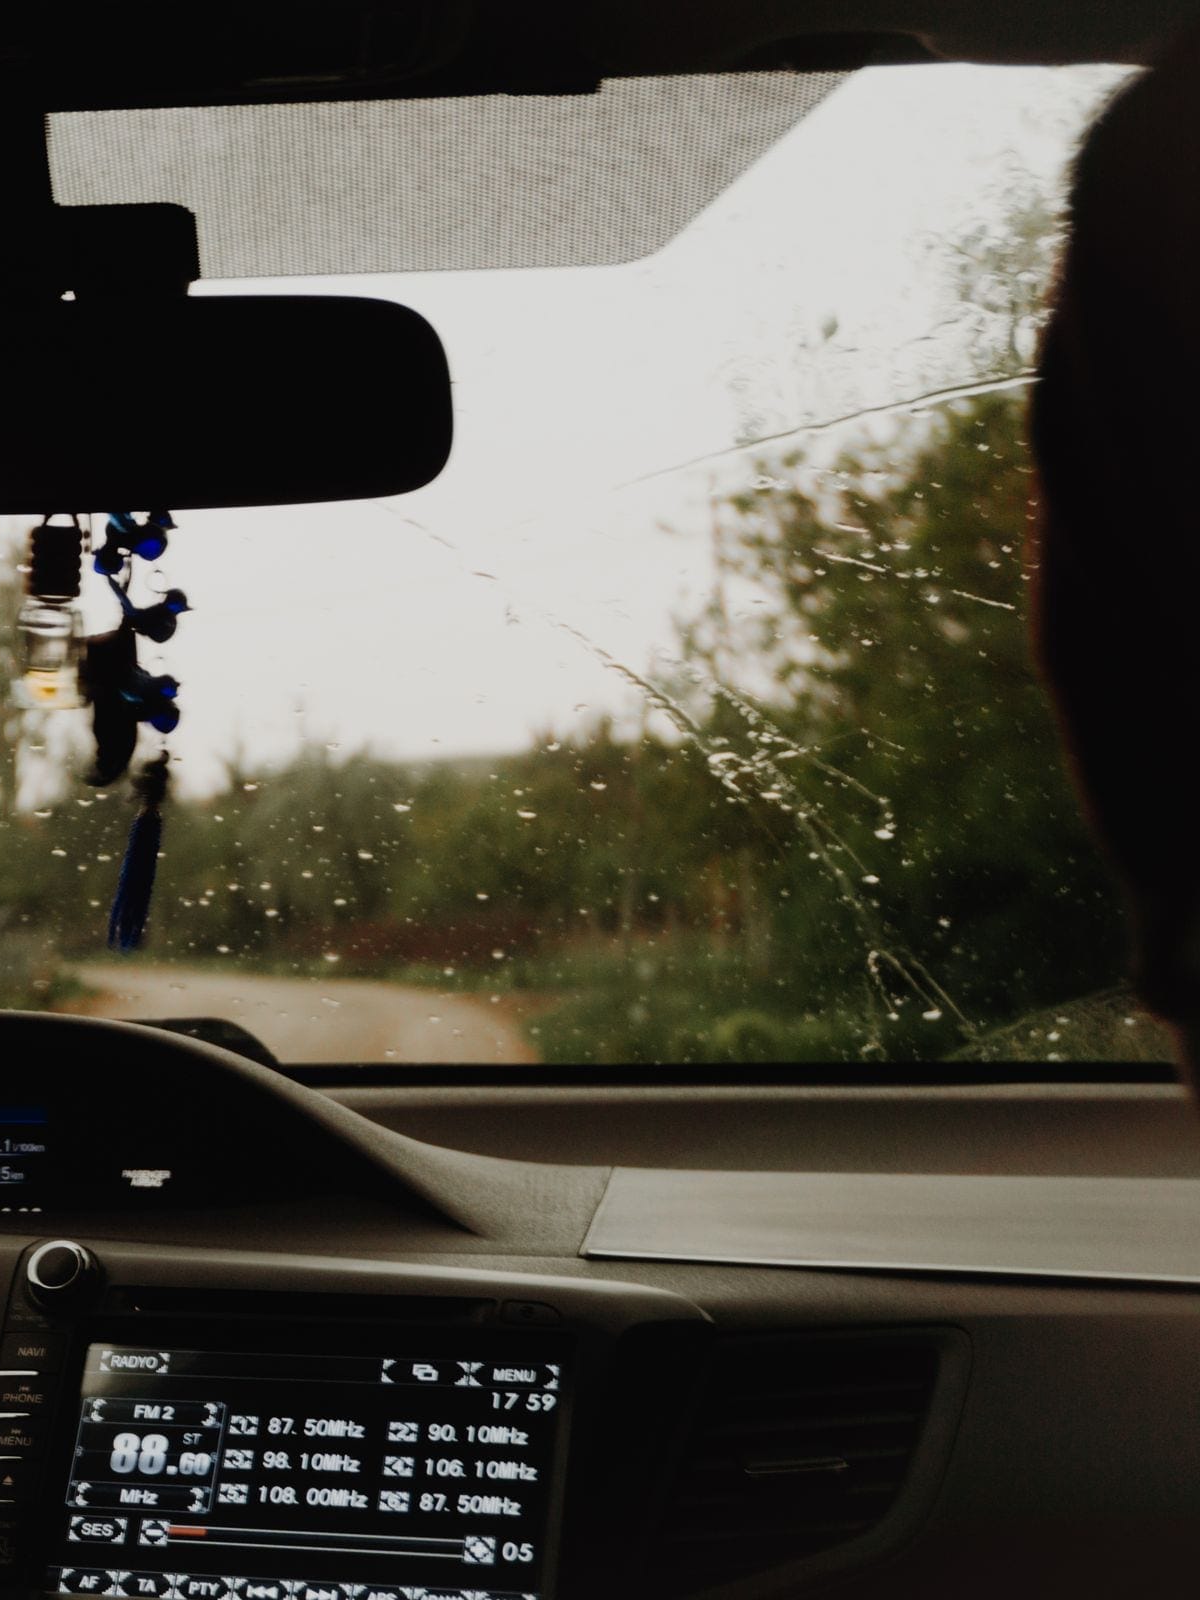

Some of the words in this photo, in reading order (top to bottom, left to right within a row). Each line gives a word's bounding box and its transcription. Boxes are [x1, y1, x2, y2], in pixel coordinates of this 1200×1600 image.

[17, 1347, 46, 1357] NAVI
[111, 1355, 158, 1369] RADYO
[492, 1368, 537, 1383] MENU
[3, 1393, 43, 1404] PHONE
[183, 1433, 202, 1446] ST
[110, 1432, 212, 1476] 88.60
[119, 1488, 160, 1505] MHz
[80, 1522, 114, 1537] SES
[502, 1541, 534, 1562] 05
[78, 1574, 100, 1589] AF
[137, 1578, 157, 1593] TA
[188, 1581, 221, 1597] PTY
